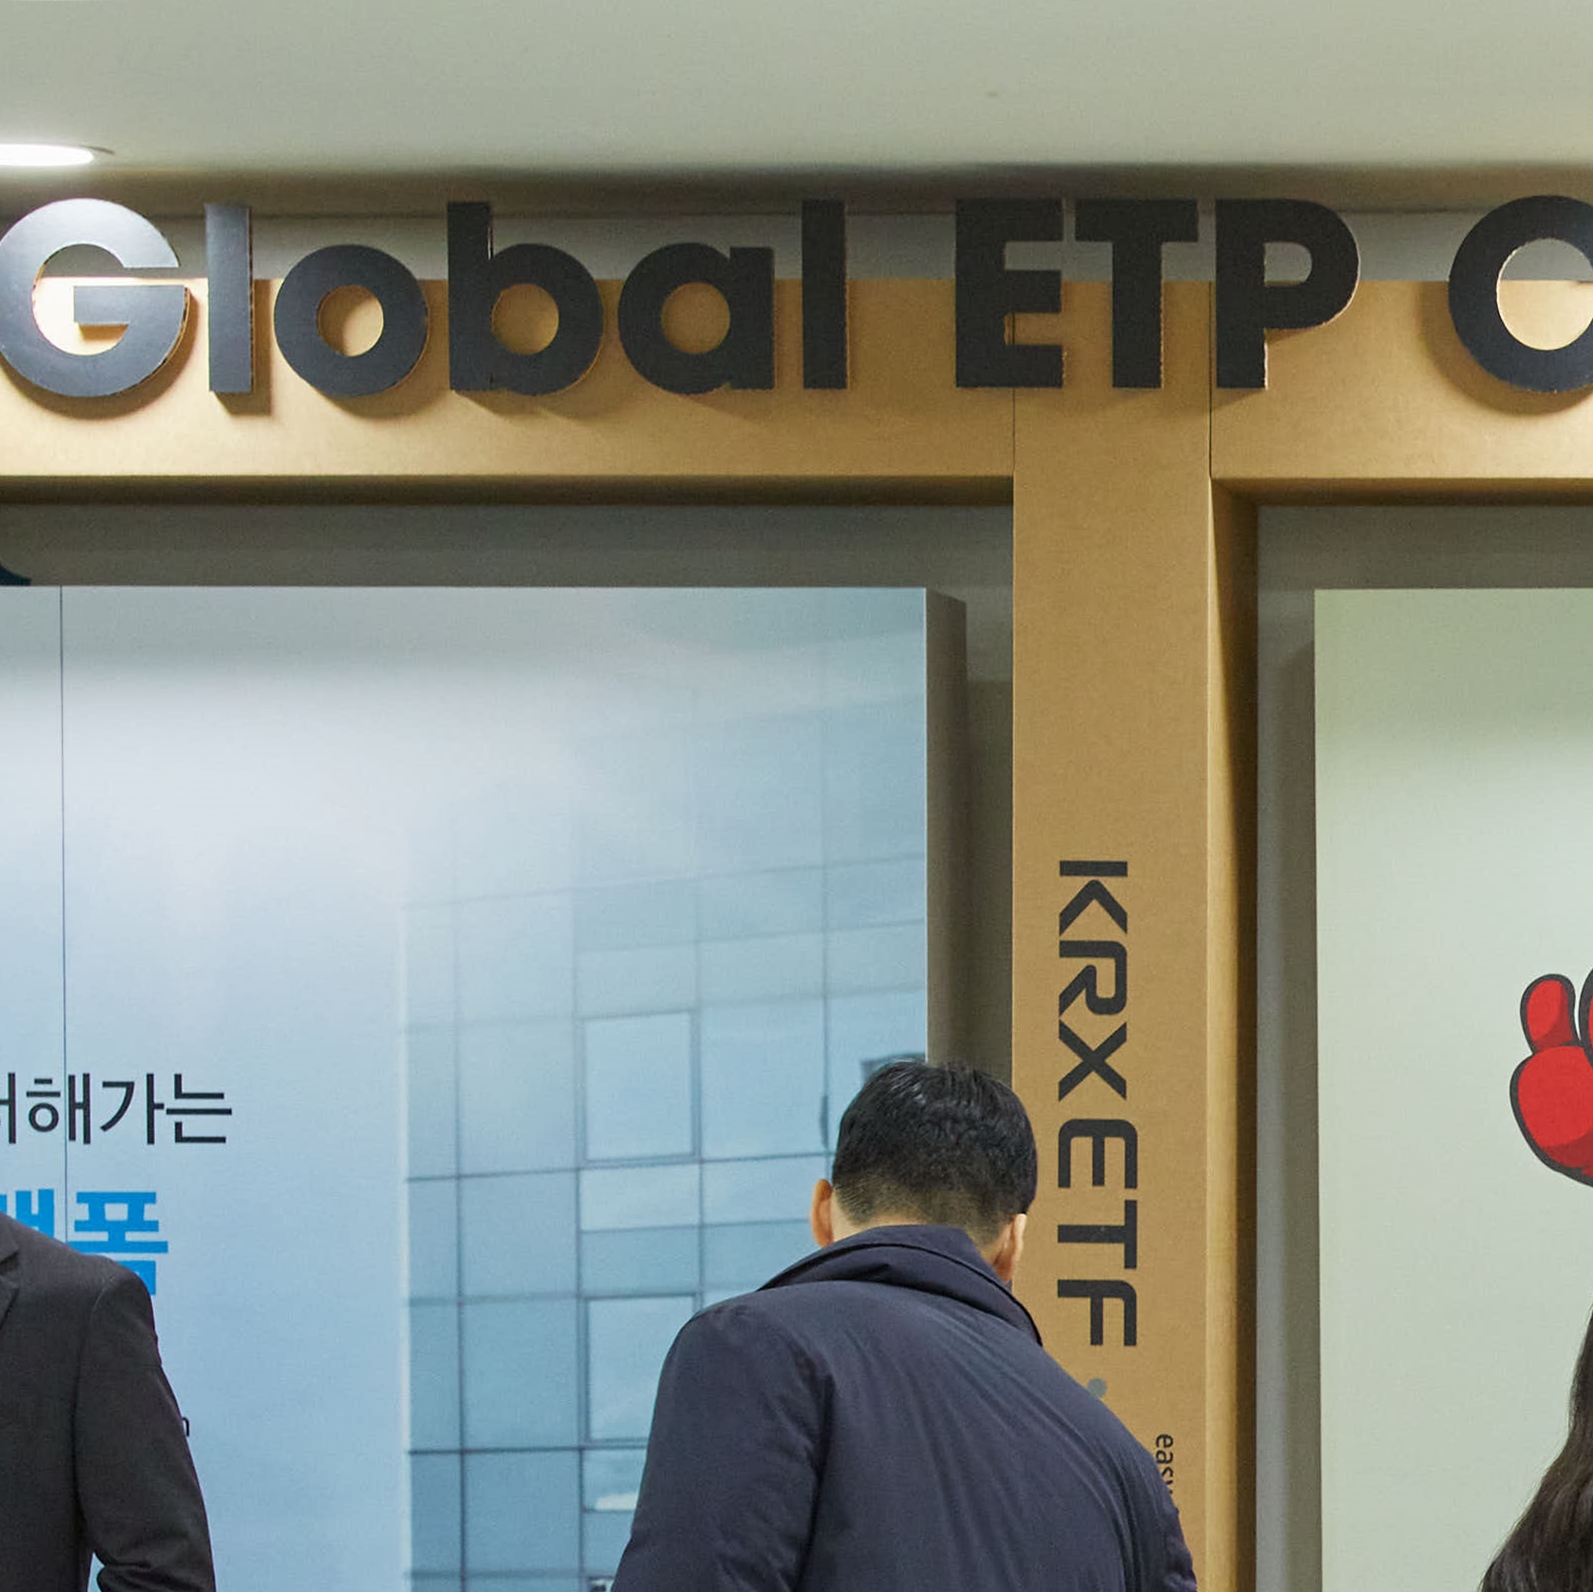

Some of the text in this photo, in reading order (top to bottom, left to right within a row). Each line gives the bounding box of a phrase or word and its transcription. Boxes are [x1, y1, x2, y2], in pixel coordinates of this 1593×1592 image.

[0, 197, 848, 397] Global
[955, 199, 1361, 391] ETP
[1057, 860, 1138, 1348] KRX ETF
[0, 1188, 168, 1296] 폼
[1155, 1433, 1174, 1495] eas
